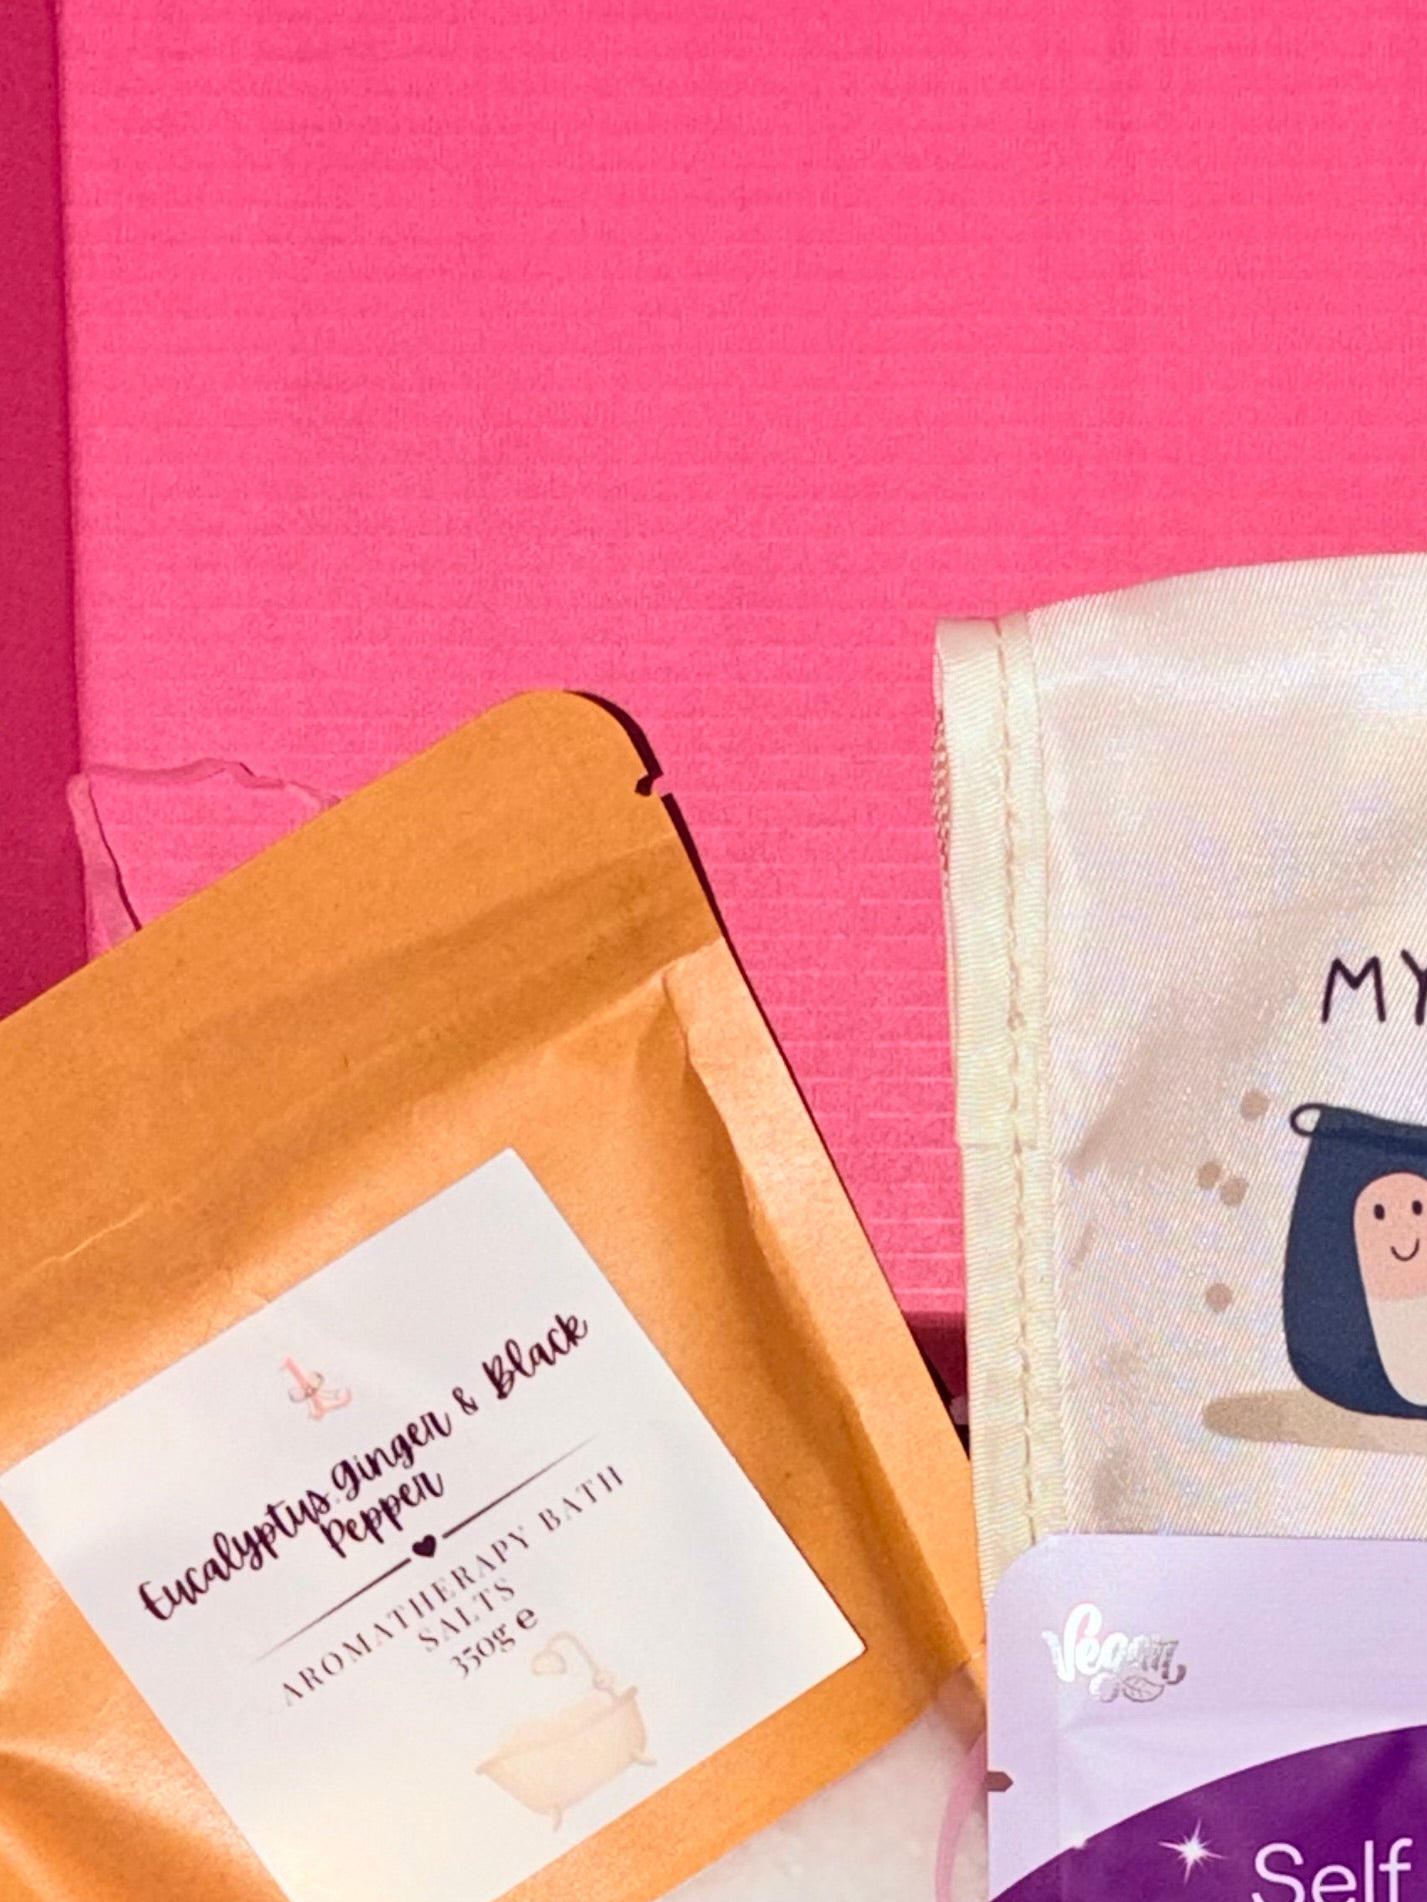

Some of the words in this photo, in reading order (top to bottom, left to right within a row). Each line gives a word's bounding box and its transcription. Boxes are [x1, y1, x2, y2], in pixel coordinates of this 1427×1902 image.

[451, 1387, 479, 1416] &
[482, 1312, 588, 1400] Black
[283, 1525, 529, 1707] AROMATHERAPY
[538, 1465, 624, 1531] BATH
[418, 1576, 516, 1652] SALTS
[450, 1622, 516, 1679] 350g
